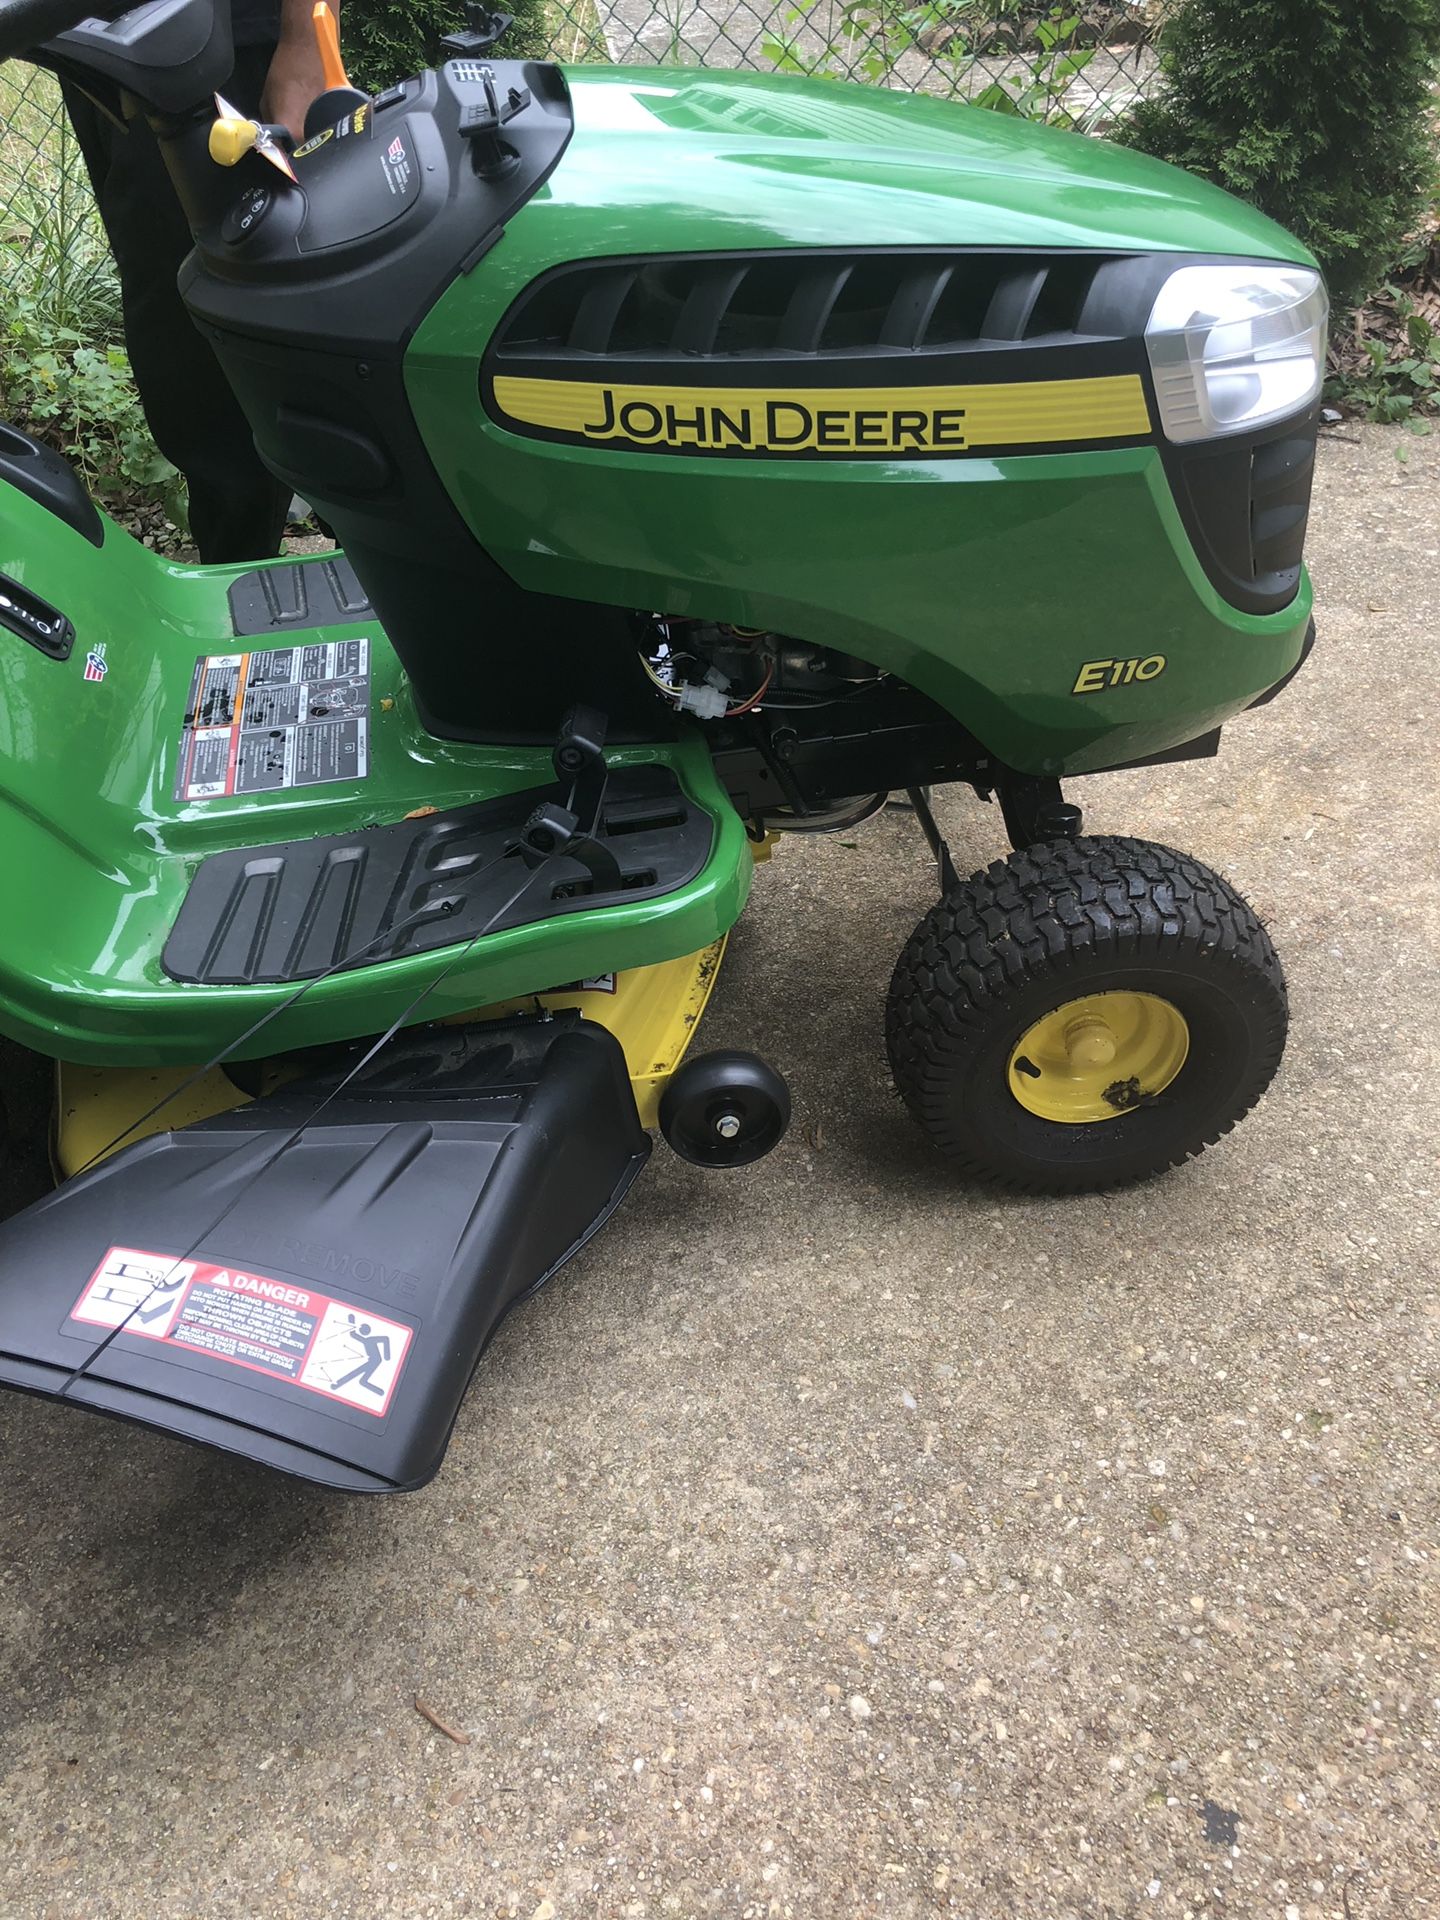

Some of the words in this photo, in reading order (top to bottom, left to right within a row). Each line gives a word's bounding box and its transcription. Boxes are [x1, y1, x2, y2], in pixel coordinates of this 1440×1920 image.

[584, 390, 752, 445] JOHN
[766, 401, 967, 446] DEERE
[1072, 654, 1166, 694] E110
[203, 1292, 217, 1300] NOT
[213, 1287, 262, 1306] ROTATING
[264, 1301, 297, 1318] BLADE
[233, 1275, 310, 1308] DANGER
[203, 1305, 246, 1323] THROWN
[247, 1318, 292, 1338] OBJECTS
